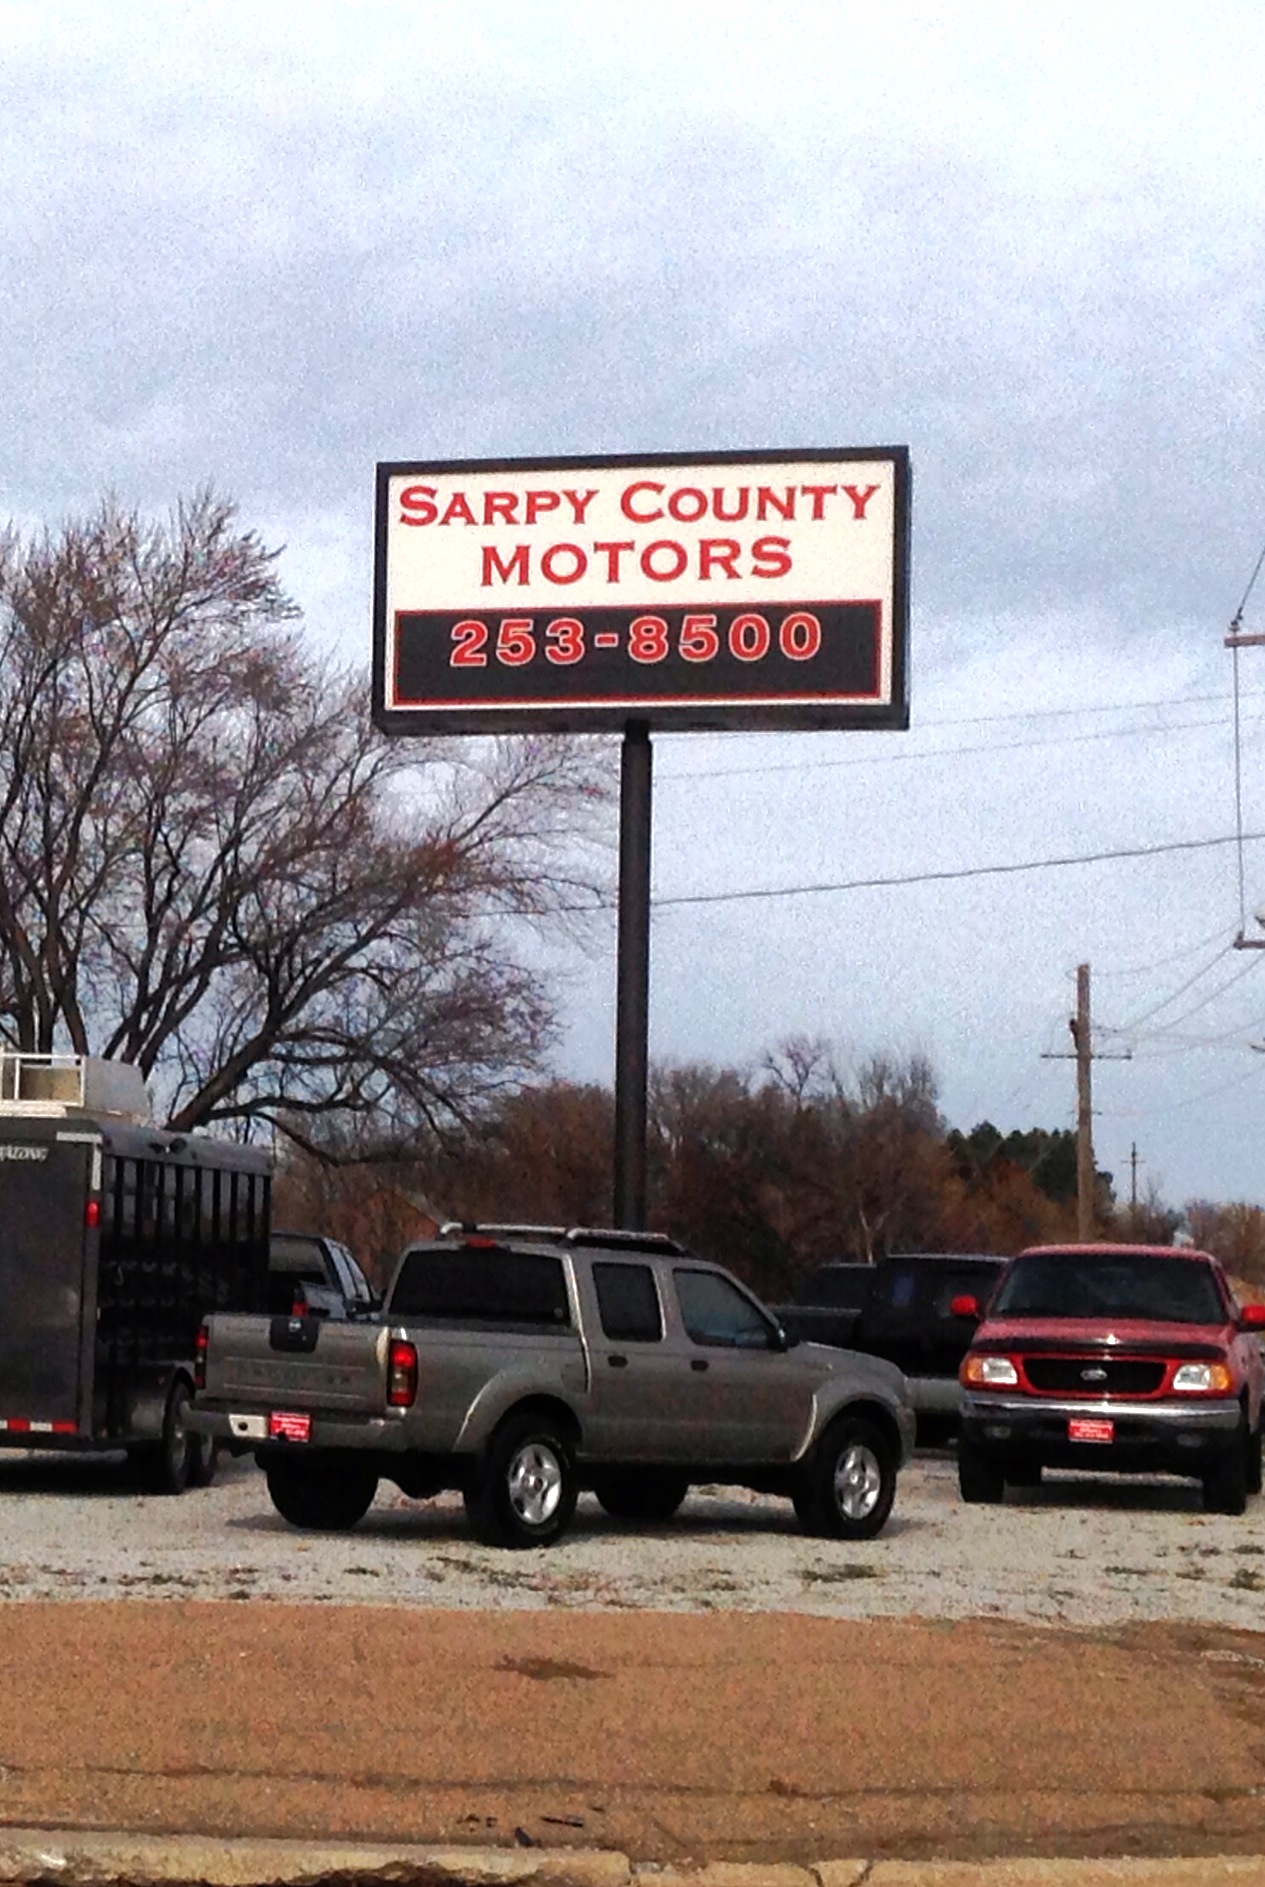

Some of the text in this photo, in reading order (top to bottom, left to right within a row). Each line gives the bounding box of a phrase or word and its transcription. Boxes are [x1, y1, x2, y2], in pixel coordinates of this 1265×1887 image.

[398, 479, 881, 528] SARPY COUNTY
[480, 535, 794, 587] MOTORS
[448, 610, 824, 669] 253-8500
